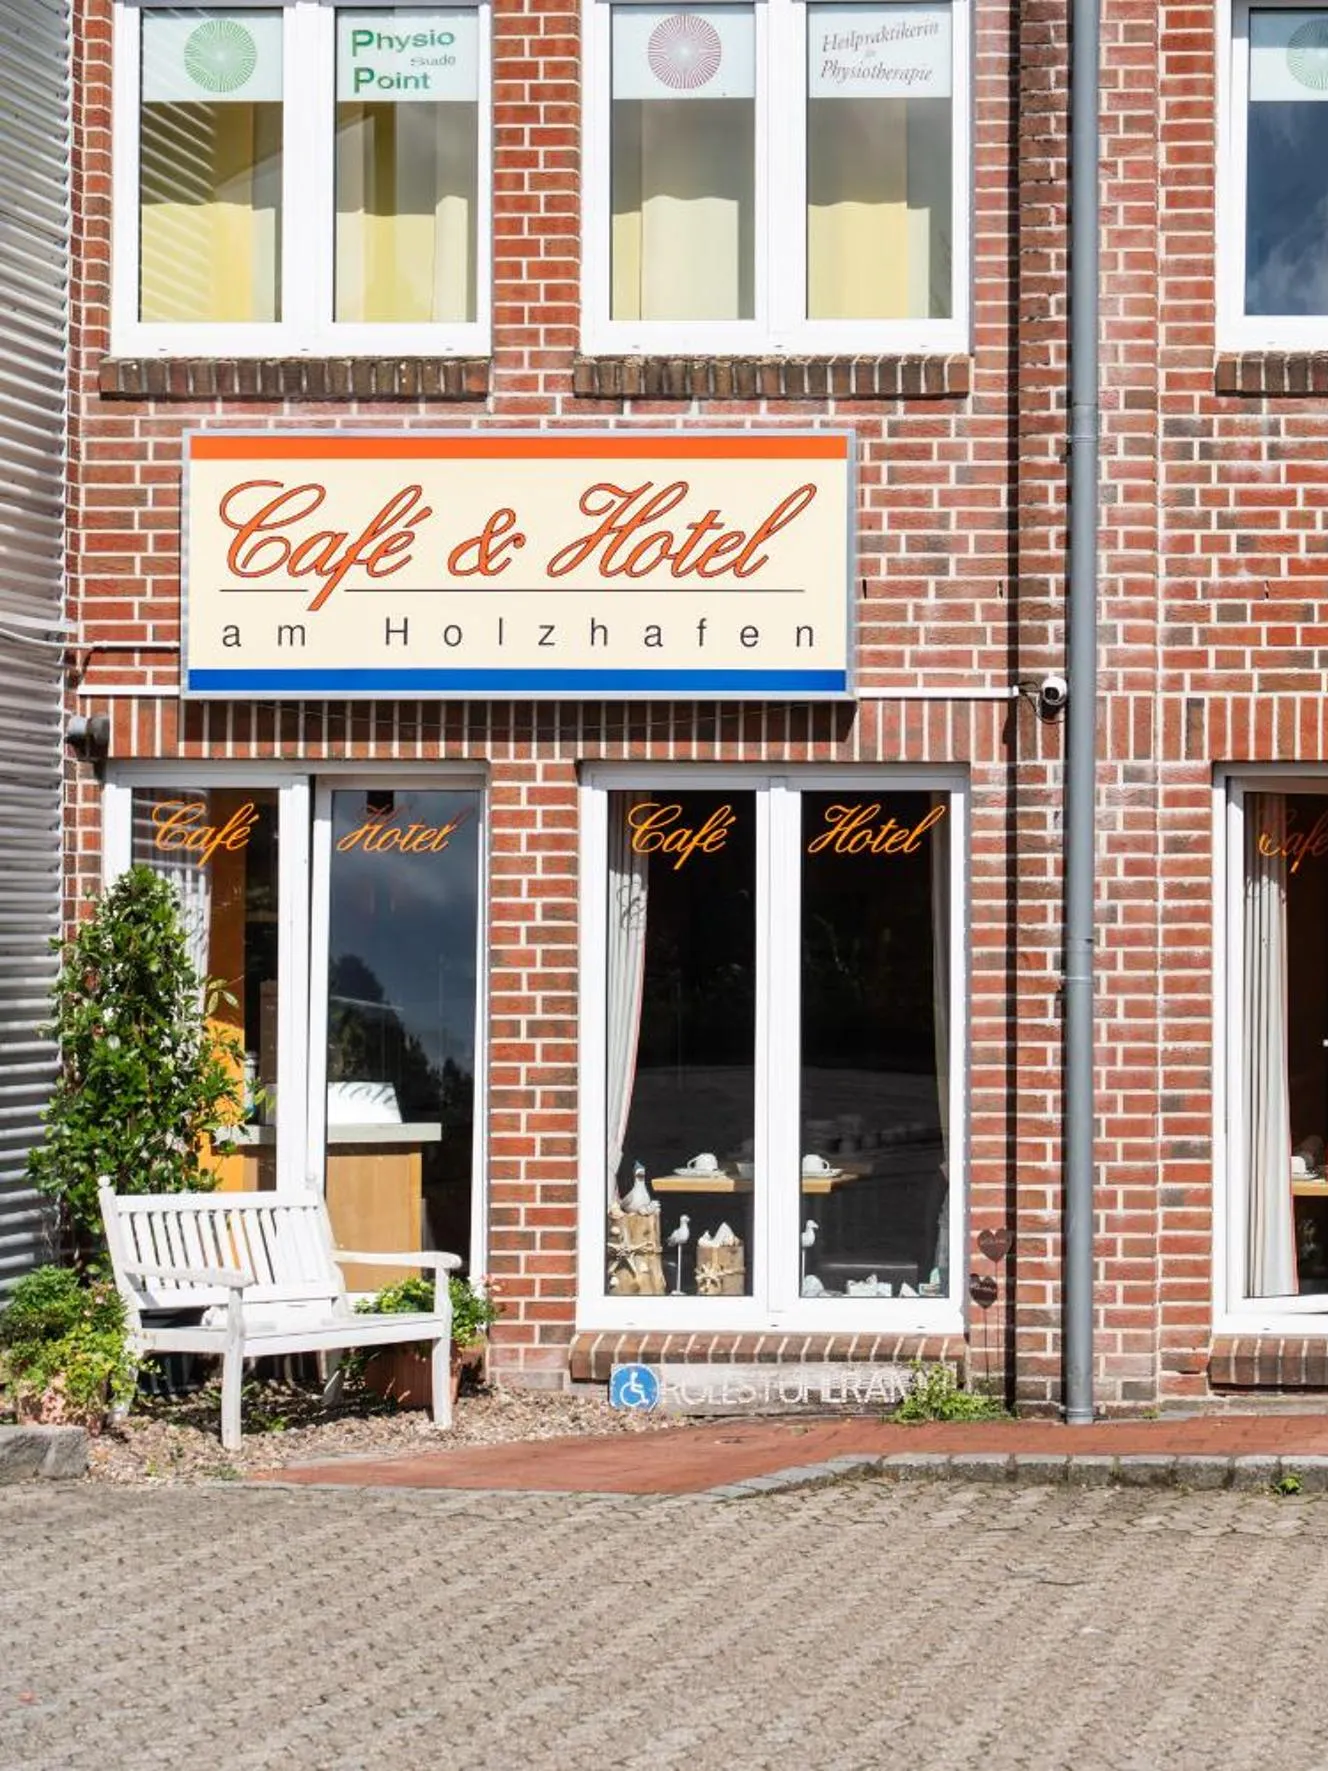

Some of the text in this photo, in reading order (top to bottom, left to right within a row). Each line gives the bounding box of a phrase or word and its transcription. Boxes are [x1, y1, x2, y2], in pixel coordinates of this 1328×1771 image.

[351, 28, 456, 57] Physio
[822, 17, 940, 53] Heilpraktikerin
[353, 66, 431, 94] Point
[821, 58, 933, 85] Physiotherapie
[218, 479, 818, 612] Café & Hotel
[221, 616, 815, 648] am Holzhafen
[151, 800, 474, 868] Café Hotel
[627, 802, 946, 871] Café Hotel
